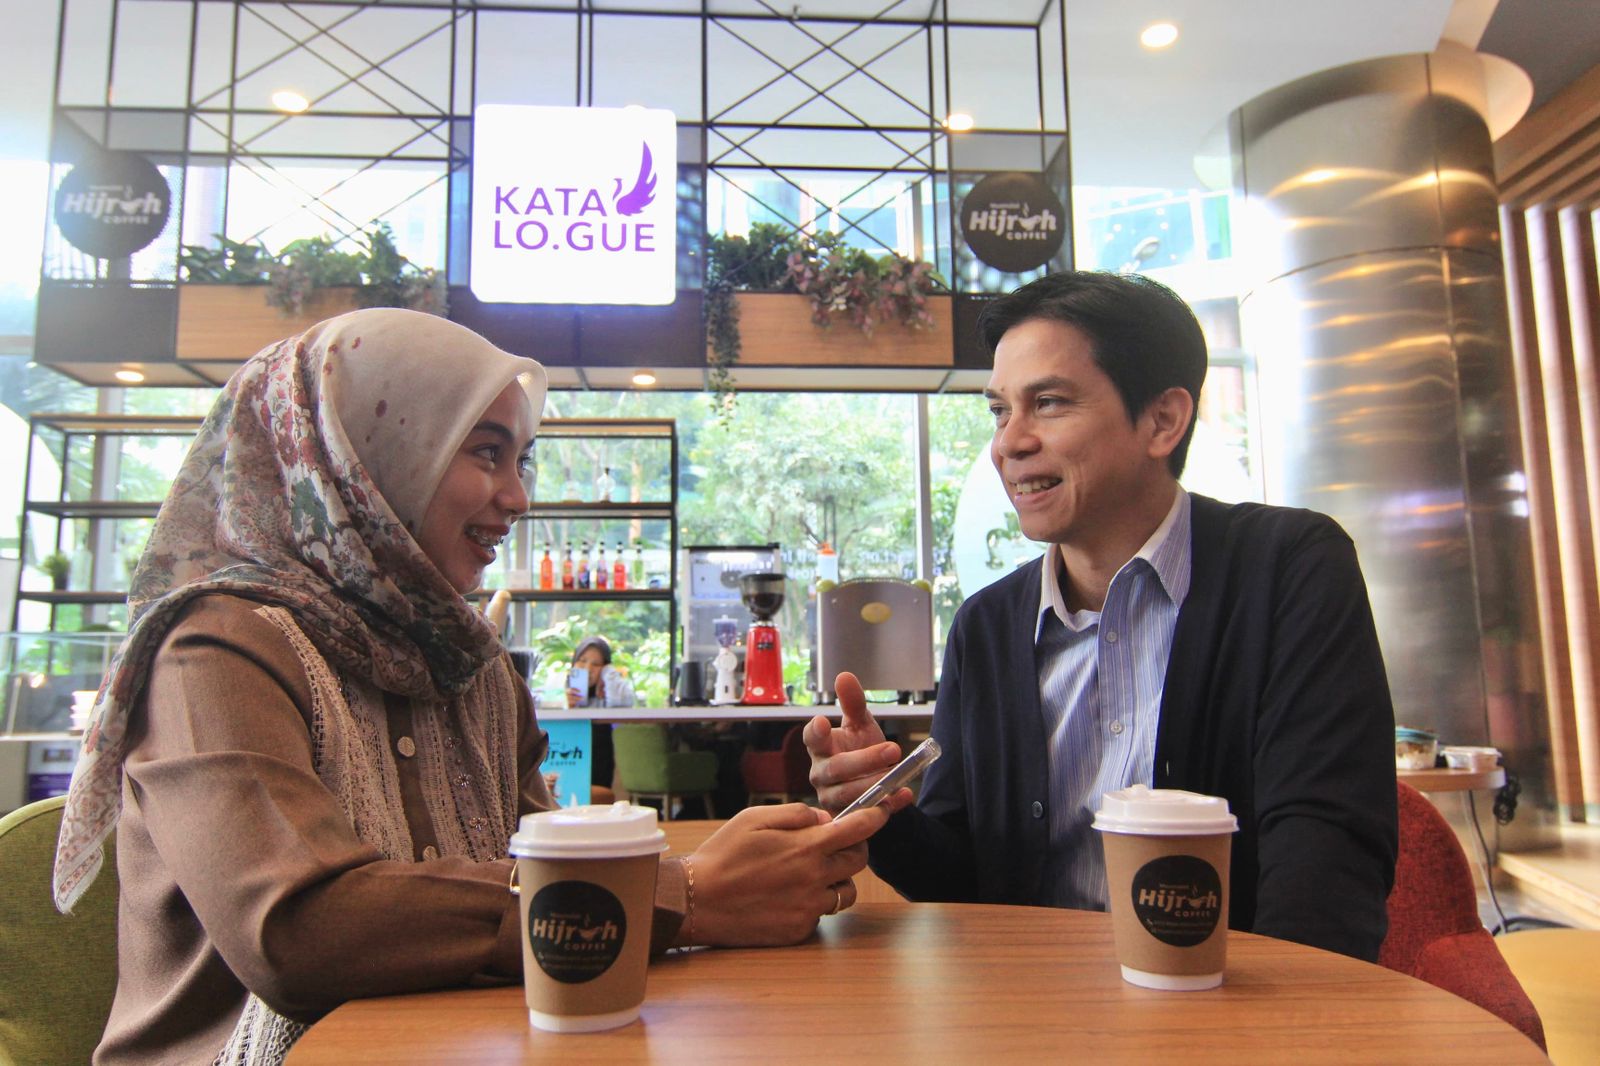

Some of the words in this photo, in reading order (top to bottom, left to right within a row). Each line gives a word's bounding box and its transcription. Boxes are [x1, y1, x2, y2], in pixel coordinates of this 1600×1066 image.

[494, 186, 607, 217] KATA
[104, 216, 149, 225] COFFEE
[494, 220, 656, 252] LO.GUE
[1006, 232, 1047, 241] COFFEE
[1175, 910, 1211, 918] COFFEE
[564, 942, 606, 951] COFFEE
